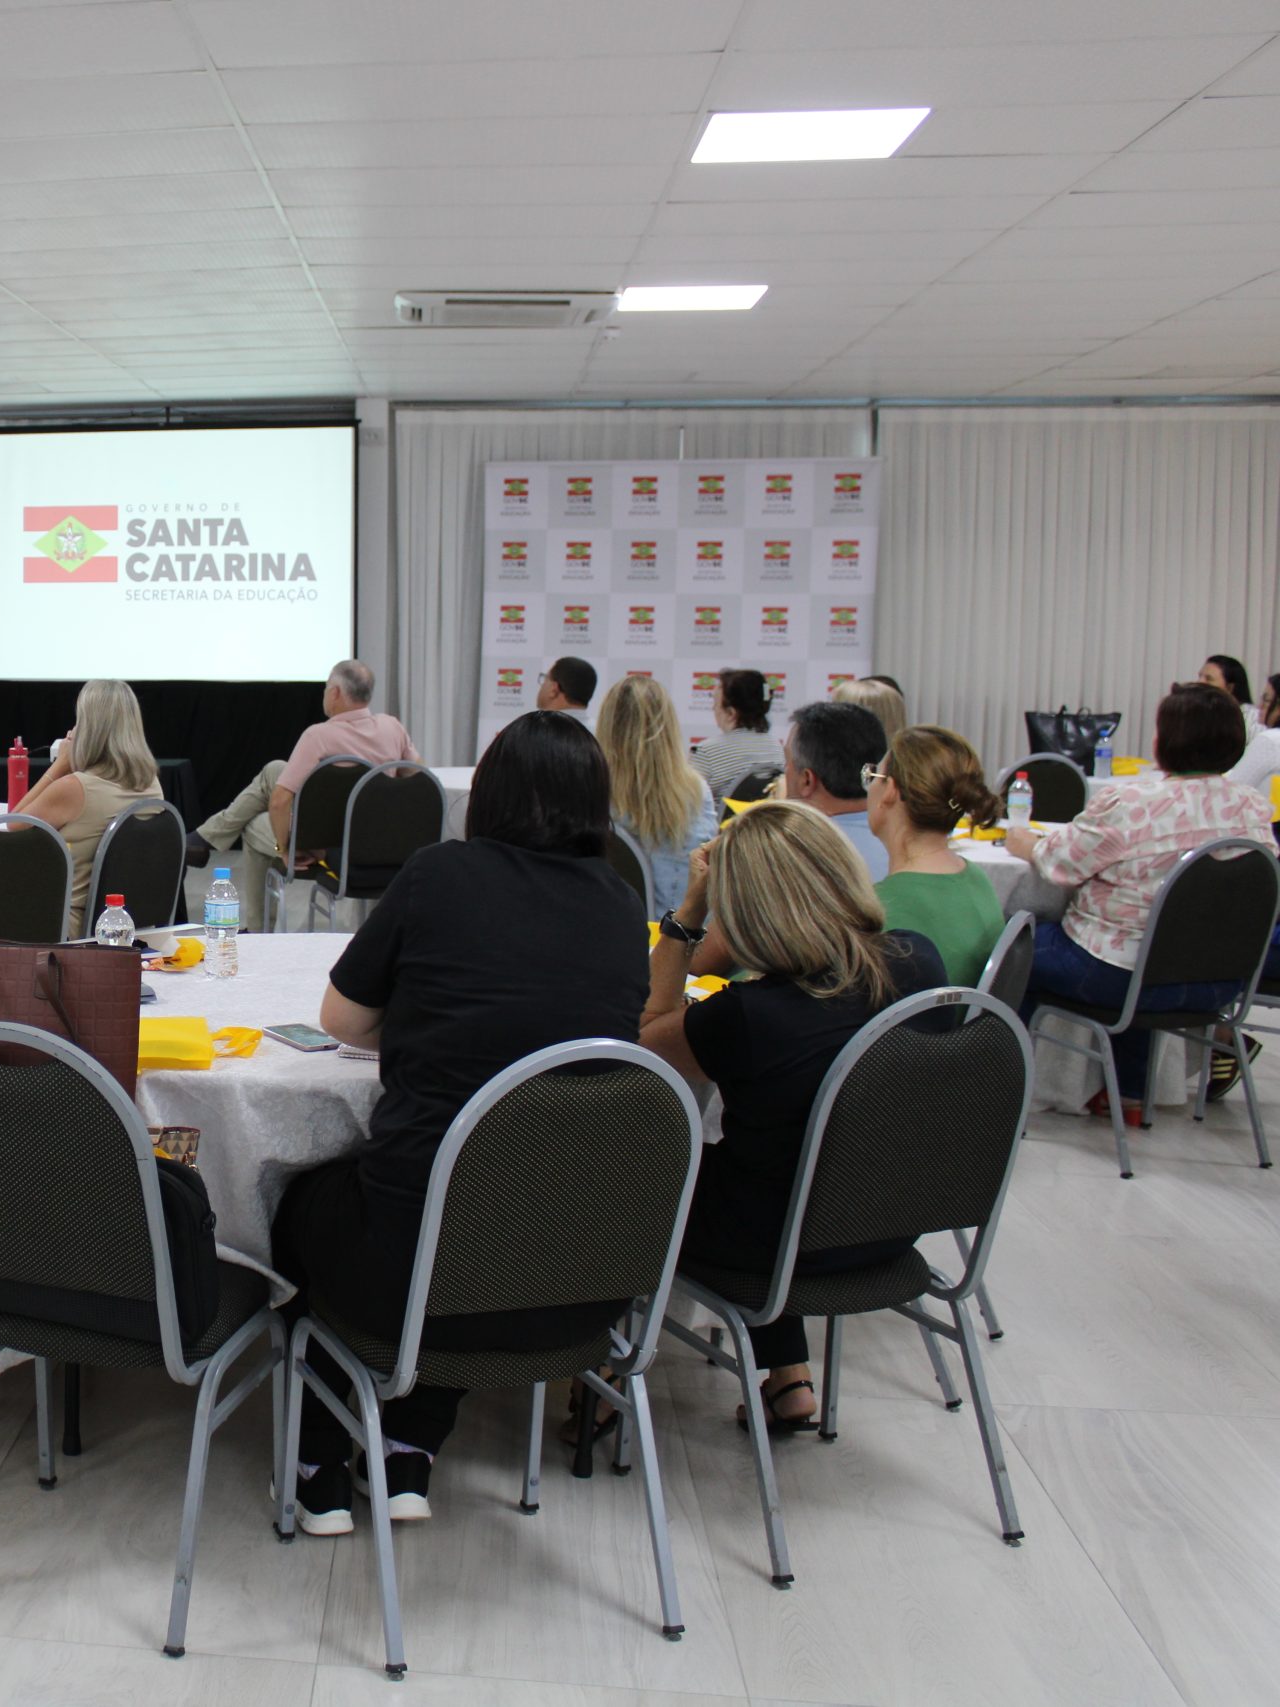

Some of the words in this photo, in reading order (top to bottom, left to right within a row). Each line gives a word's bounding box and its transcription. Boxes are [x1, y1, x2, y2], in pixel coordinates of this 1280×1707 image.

[125, 503, 208, 513] GOVERNO
[221, 502, 241, 512] DE
[125, 517, 250, 548] SANTA
[125, 551, 318, 583] CATARINA
[125, 588, 209, 601] SECRETARIA
[213, 588, 233, 601] DA
[238, 586, 318, 603] EDUCAÇÃO
